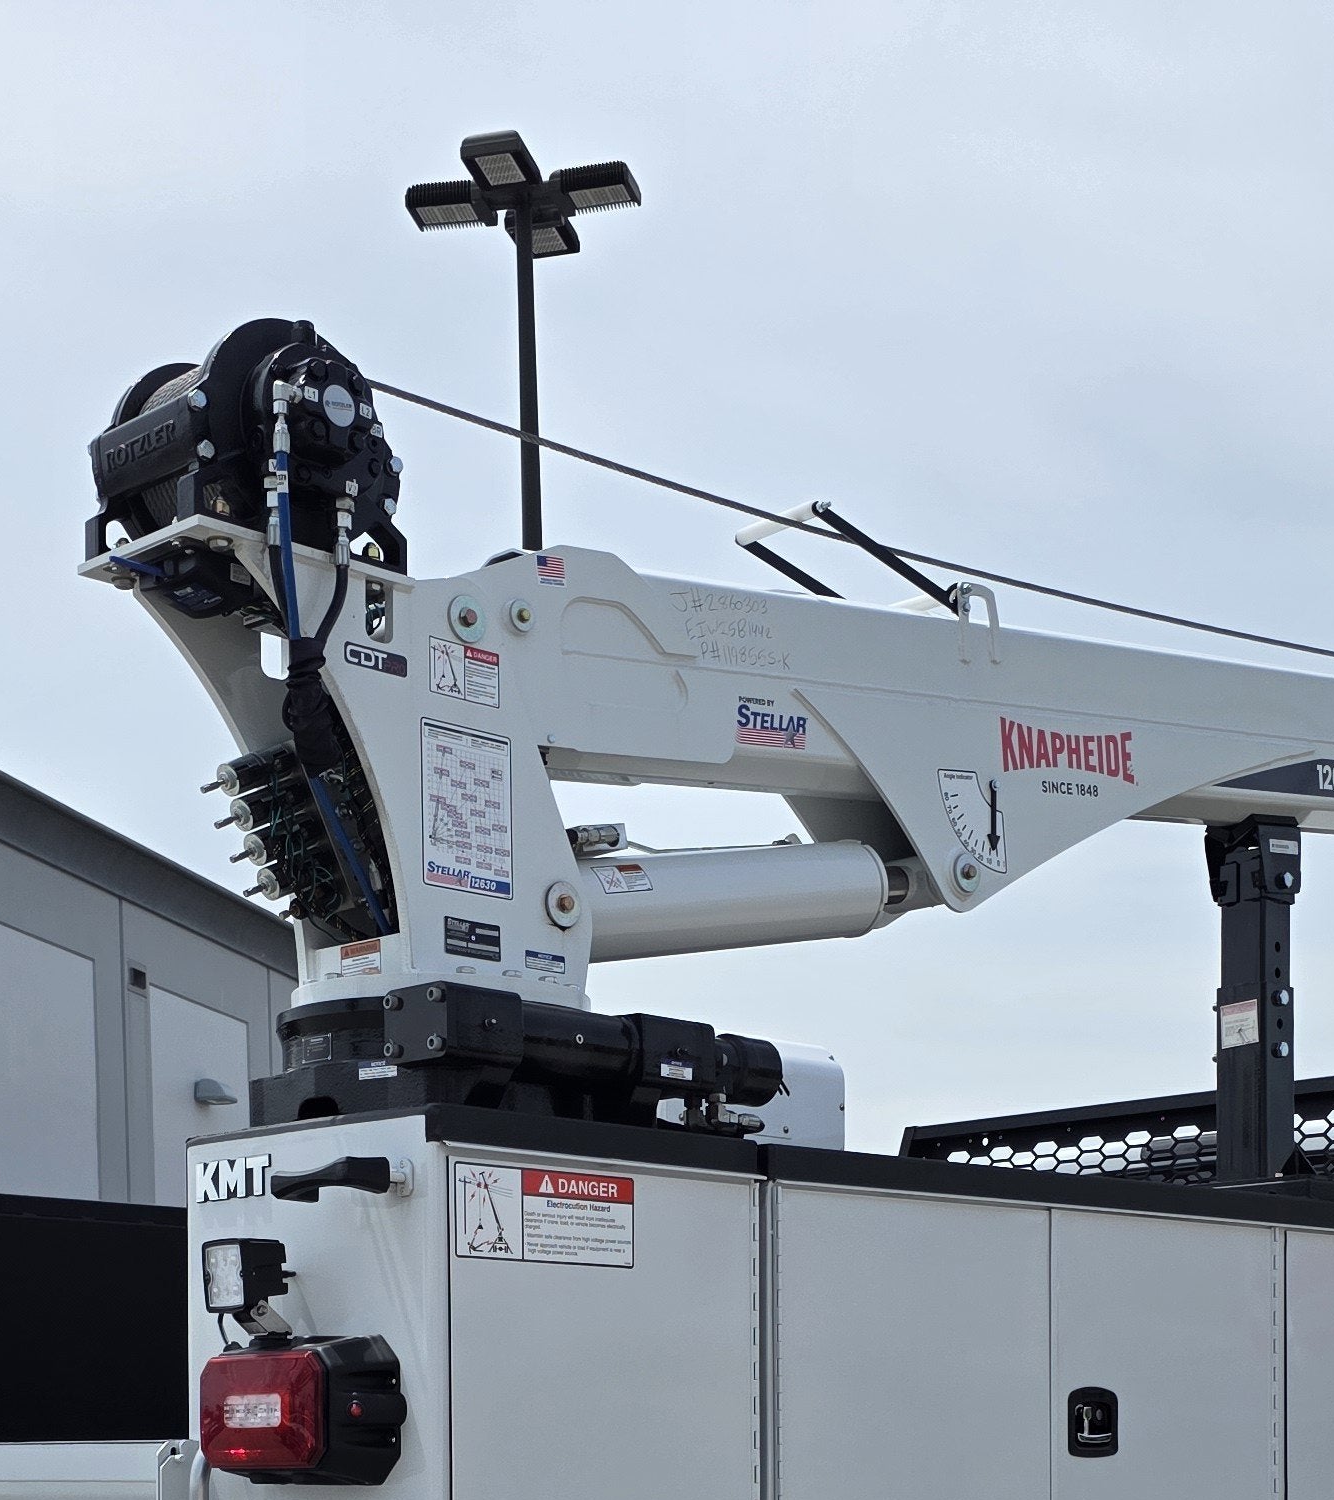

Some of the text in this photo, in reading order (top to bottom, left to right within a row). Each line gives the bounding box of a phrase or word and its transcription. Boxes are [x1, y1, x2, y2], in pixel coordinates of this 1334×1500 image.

[473, 652, 497, 663] DANGER
[739, 696, 765, 706] POWERED
[737, 704, 806, 734] STELLAR
[999, 716, 1135, 785] KNAPHEIDE
[1041, 780, 1099, 798] SINCE 1848
[427, 861, 471, 878] STELLAR
[471, 878, 496, 890] 12630
[195, 1152, 270, 1203] KMT
[558, 1179, 618, 1197] DANGER
[547, 1200, 610, 1212] Electrocution Hazard
